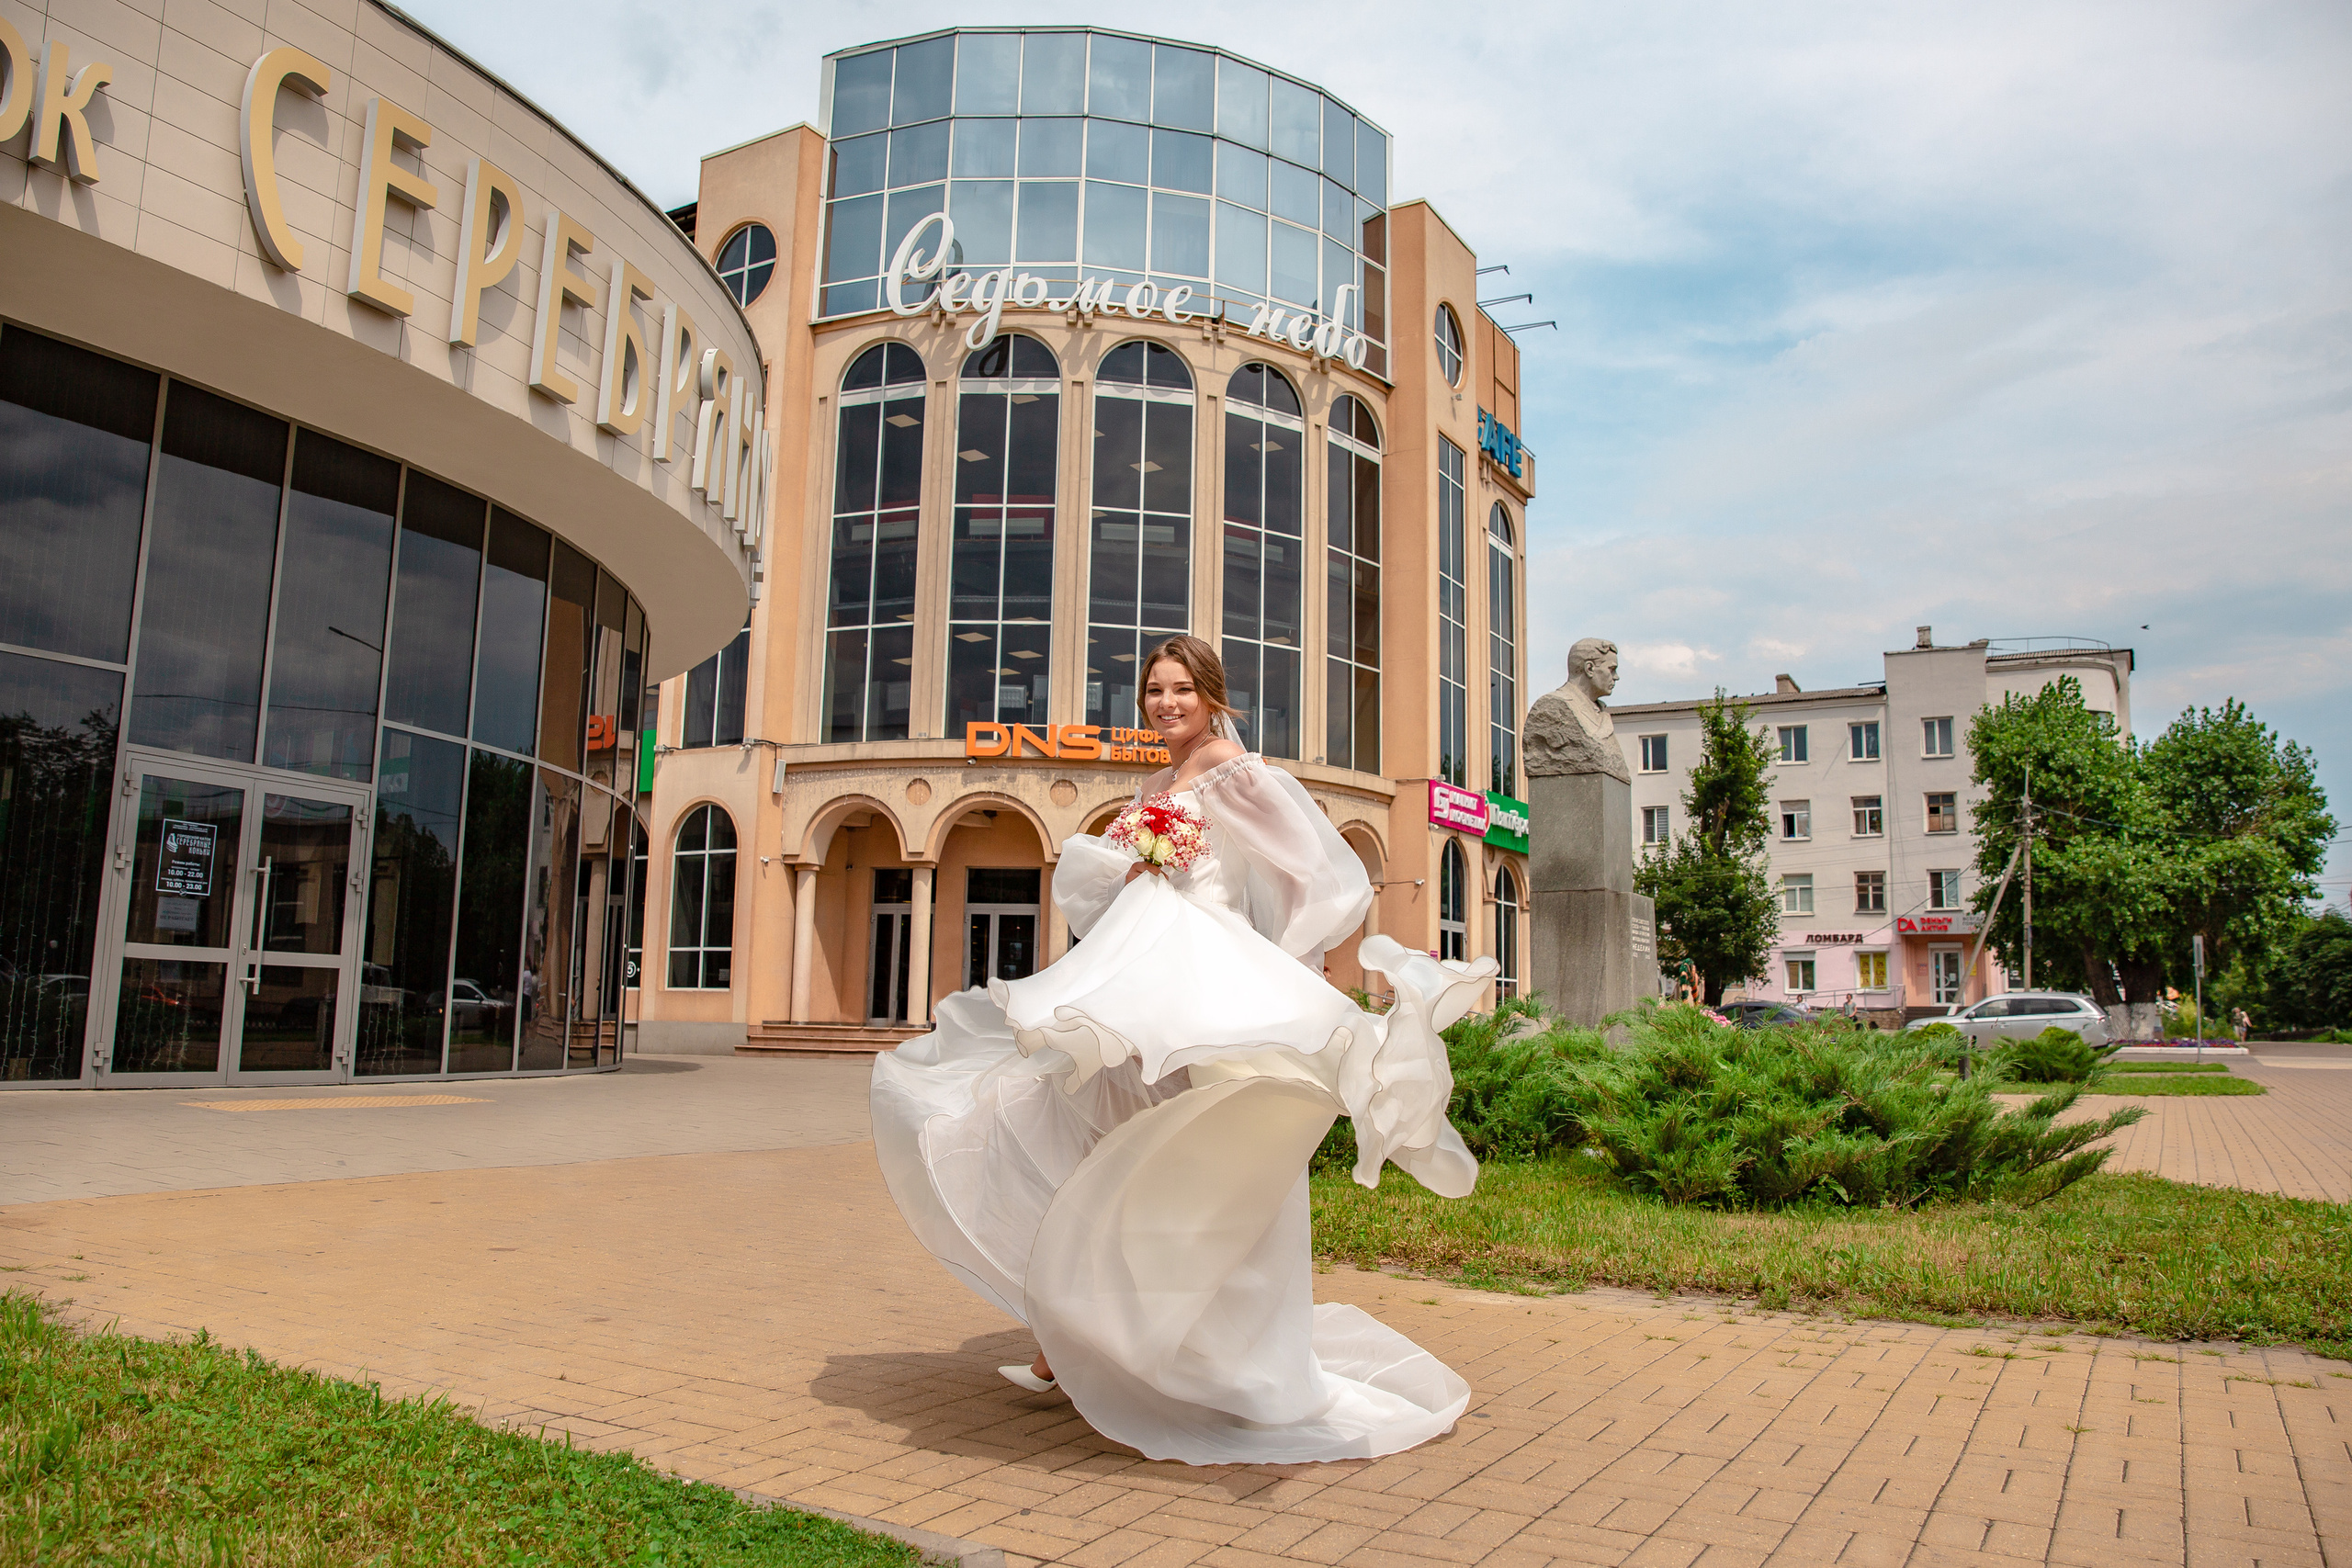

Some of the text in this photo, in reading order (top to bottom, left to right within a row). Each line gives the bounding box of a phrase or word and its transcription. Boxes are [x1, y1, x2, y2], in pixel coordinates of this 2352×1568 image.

[1247, 283, 1367, 370] небо
[966, 721, 1102, 761] DNS
[1111, 726, 1168, 744] ЦИФР
[1110, 746, 1173, 764] БЫТОВ
[167, 868, 184, 876] 10.00
[187, 871, 204, 879] 22.00
[165, 881, 183, 889] 10.00
[186, 883, 202, 891] 23.00
[1805, 933, 1864, 944] ЛОМБАРД
